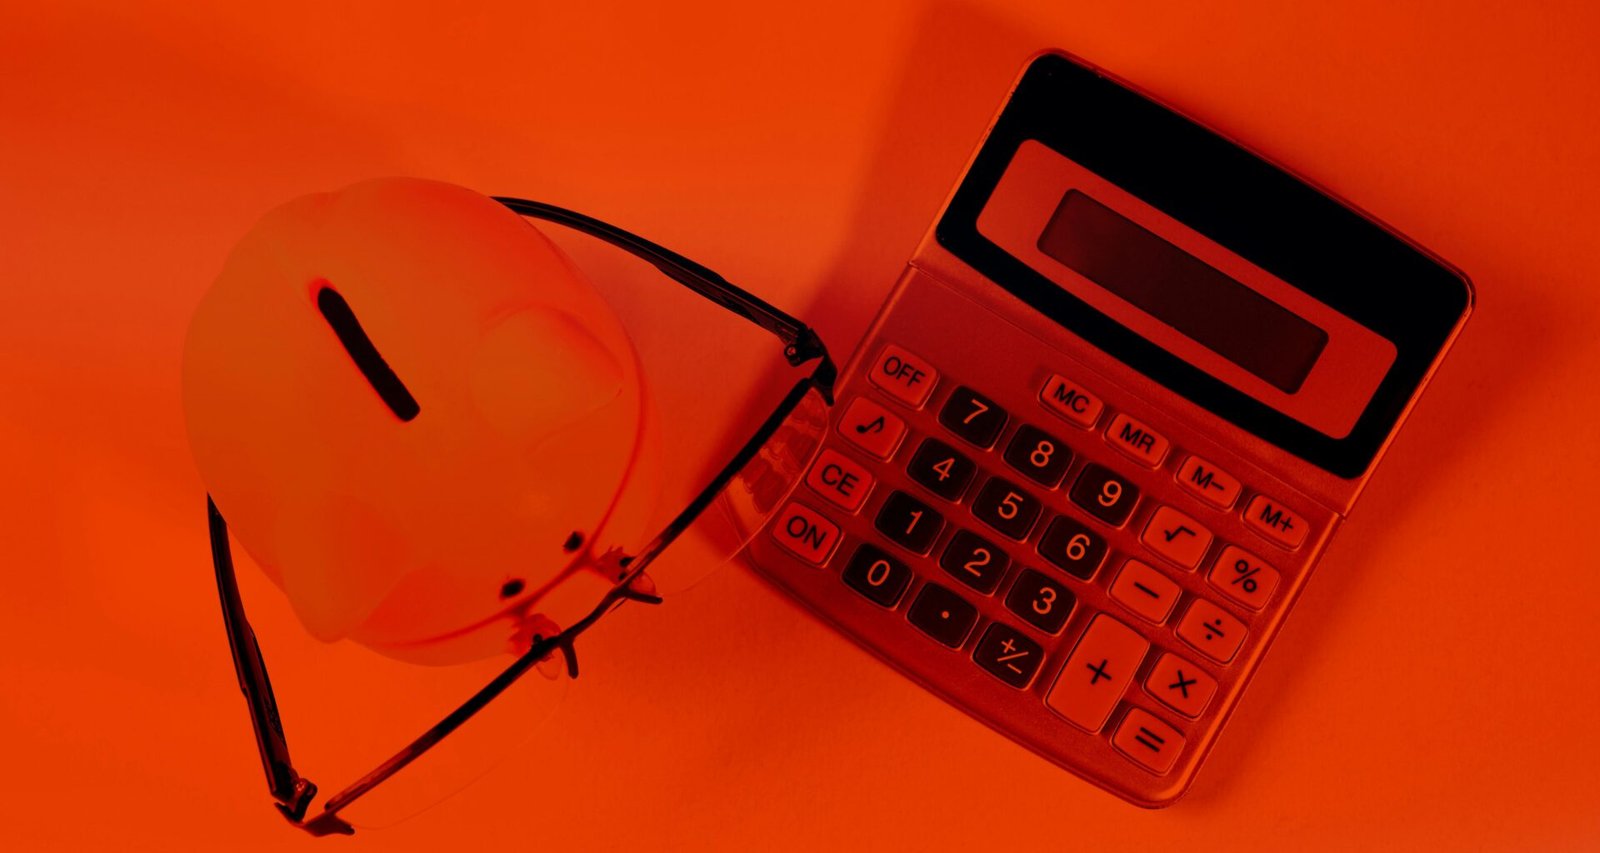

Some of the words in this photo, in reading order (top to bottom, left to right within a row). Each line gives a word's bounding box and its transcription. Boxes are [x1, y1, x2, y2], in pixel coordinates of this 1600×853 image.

[883, 355, 926, 388] OFF
[964, 399, 988, 424] 7
[1052, 381, 1091, 415] MC
[1119, 422, 1157, 455] MR
[1030, 441, 1054, 467] 8
[821, 463, 860, 497] CE
[933, 458, 955, 481] 4
[999, 492, 1024, 519] 5
[1098, 480, 1122, 507] 9
[905, 510, 923, 534] 1
[1259, 503, 1295, 533] M+
[785, 515, 827, 550] ON
[1066, 533, 1090, 560] 6
[867, 559, 891, 586] 0
[964, 548, 991, 576] 2
[1231, 558, 1262, 594] %
[1033, 587, 1057, 614] 3
[1086, 659, 1113, 686] +
